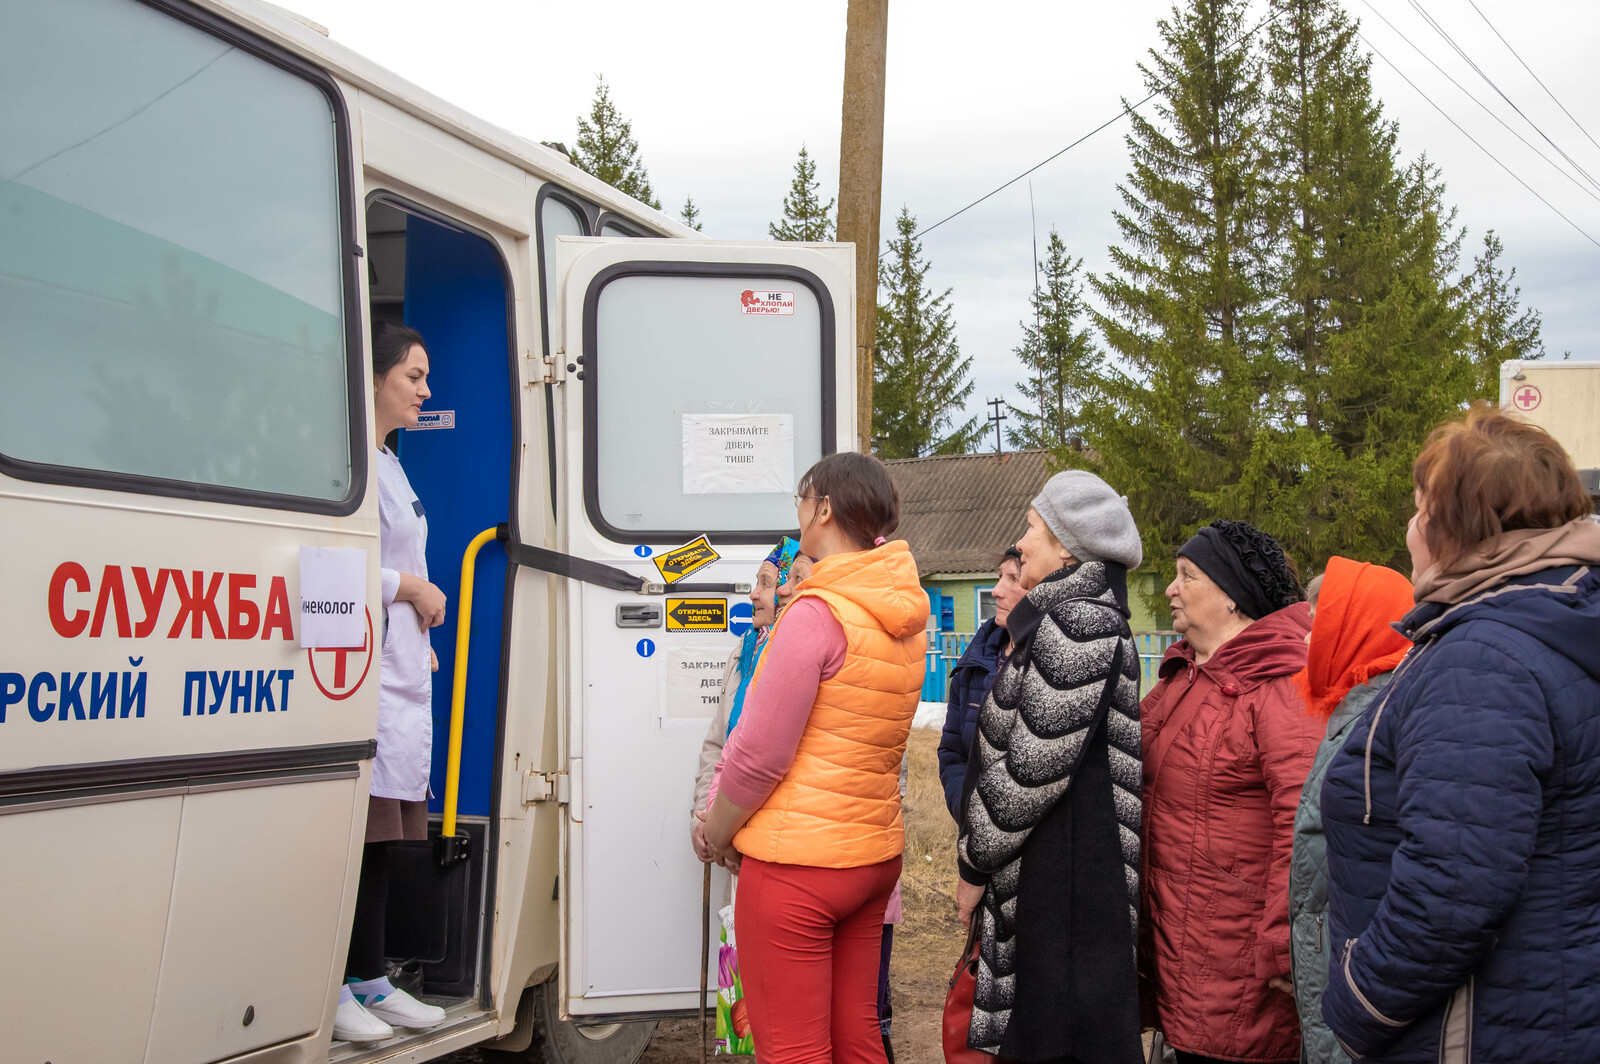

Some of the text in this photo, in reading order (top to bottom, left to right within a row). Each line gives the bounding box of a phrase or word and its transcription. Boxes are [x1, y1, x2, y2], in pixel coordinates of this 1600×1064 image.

[768, 293, 782, 301] НЕ
[760, 300, 793, 308] ХЛОПАЙ
[746, 306, 780, 314] ДВЕРЬЮ!
[709, 426, 769, 436] ЗАКРЫВАЙТЕ
[725, 441, 754, 450] ДВЕРЬ
[725, 455, 754, 464] ТИШЕ!
[668, 548, 707, 566] ОТКРЫВАТЬ
[680, 554, 702, 567] ЗДЕСЬ
[48, 561, 295, 641] СЛУЖБА
[301, 598, 356, 615] инеколог
[677, 608, 722, 616] ОТКРЫВАТЬ
[0, 656, 295, 724] РСКИЙ ПУНКТ
